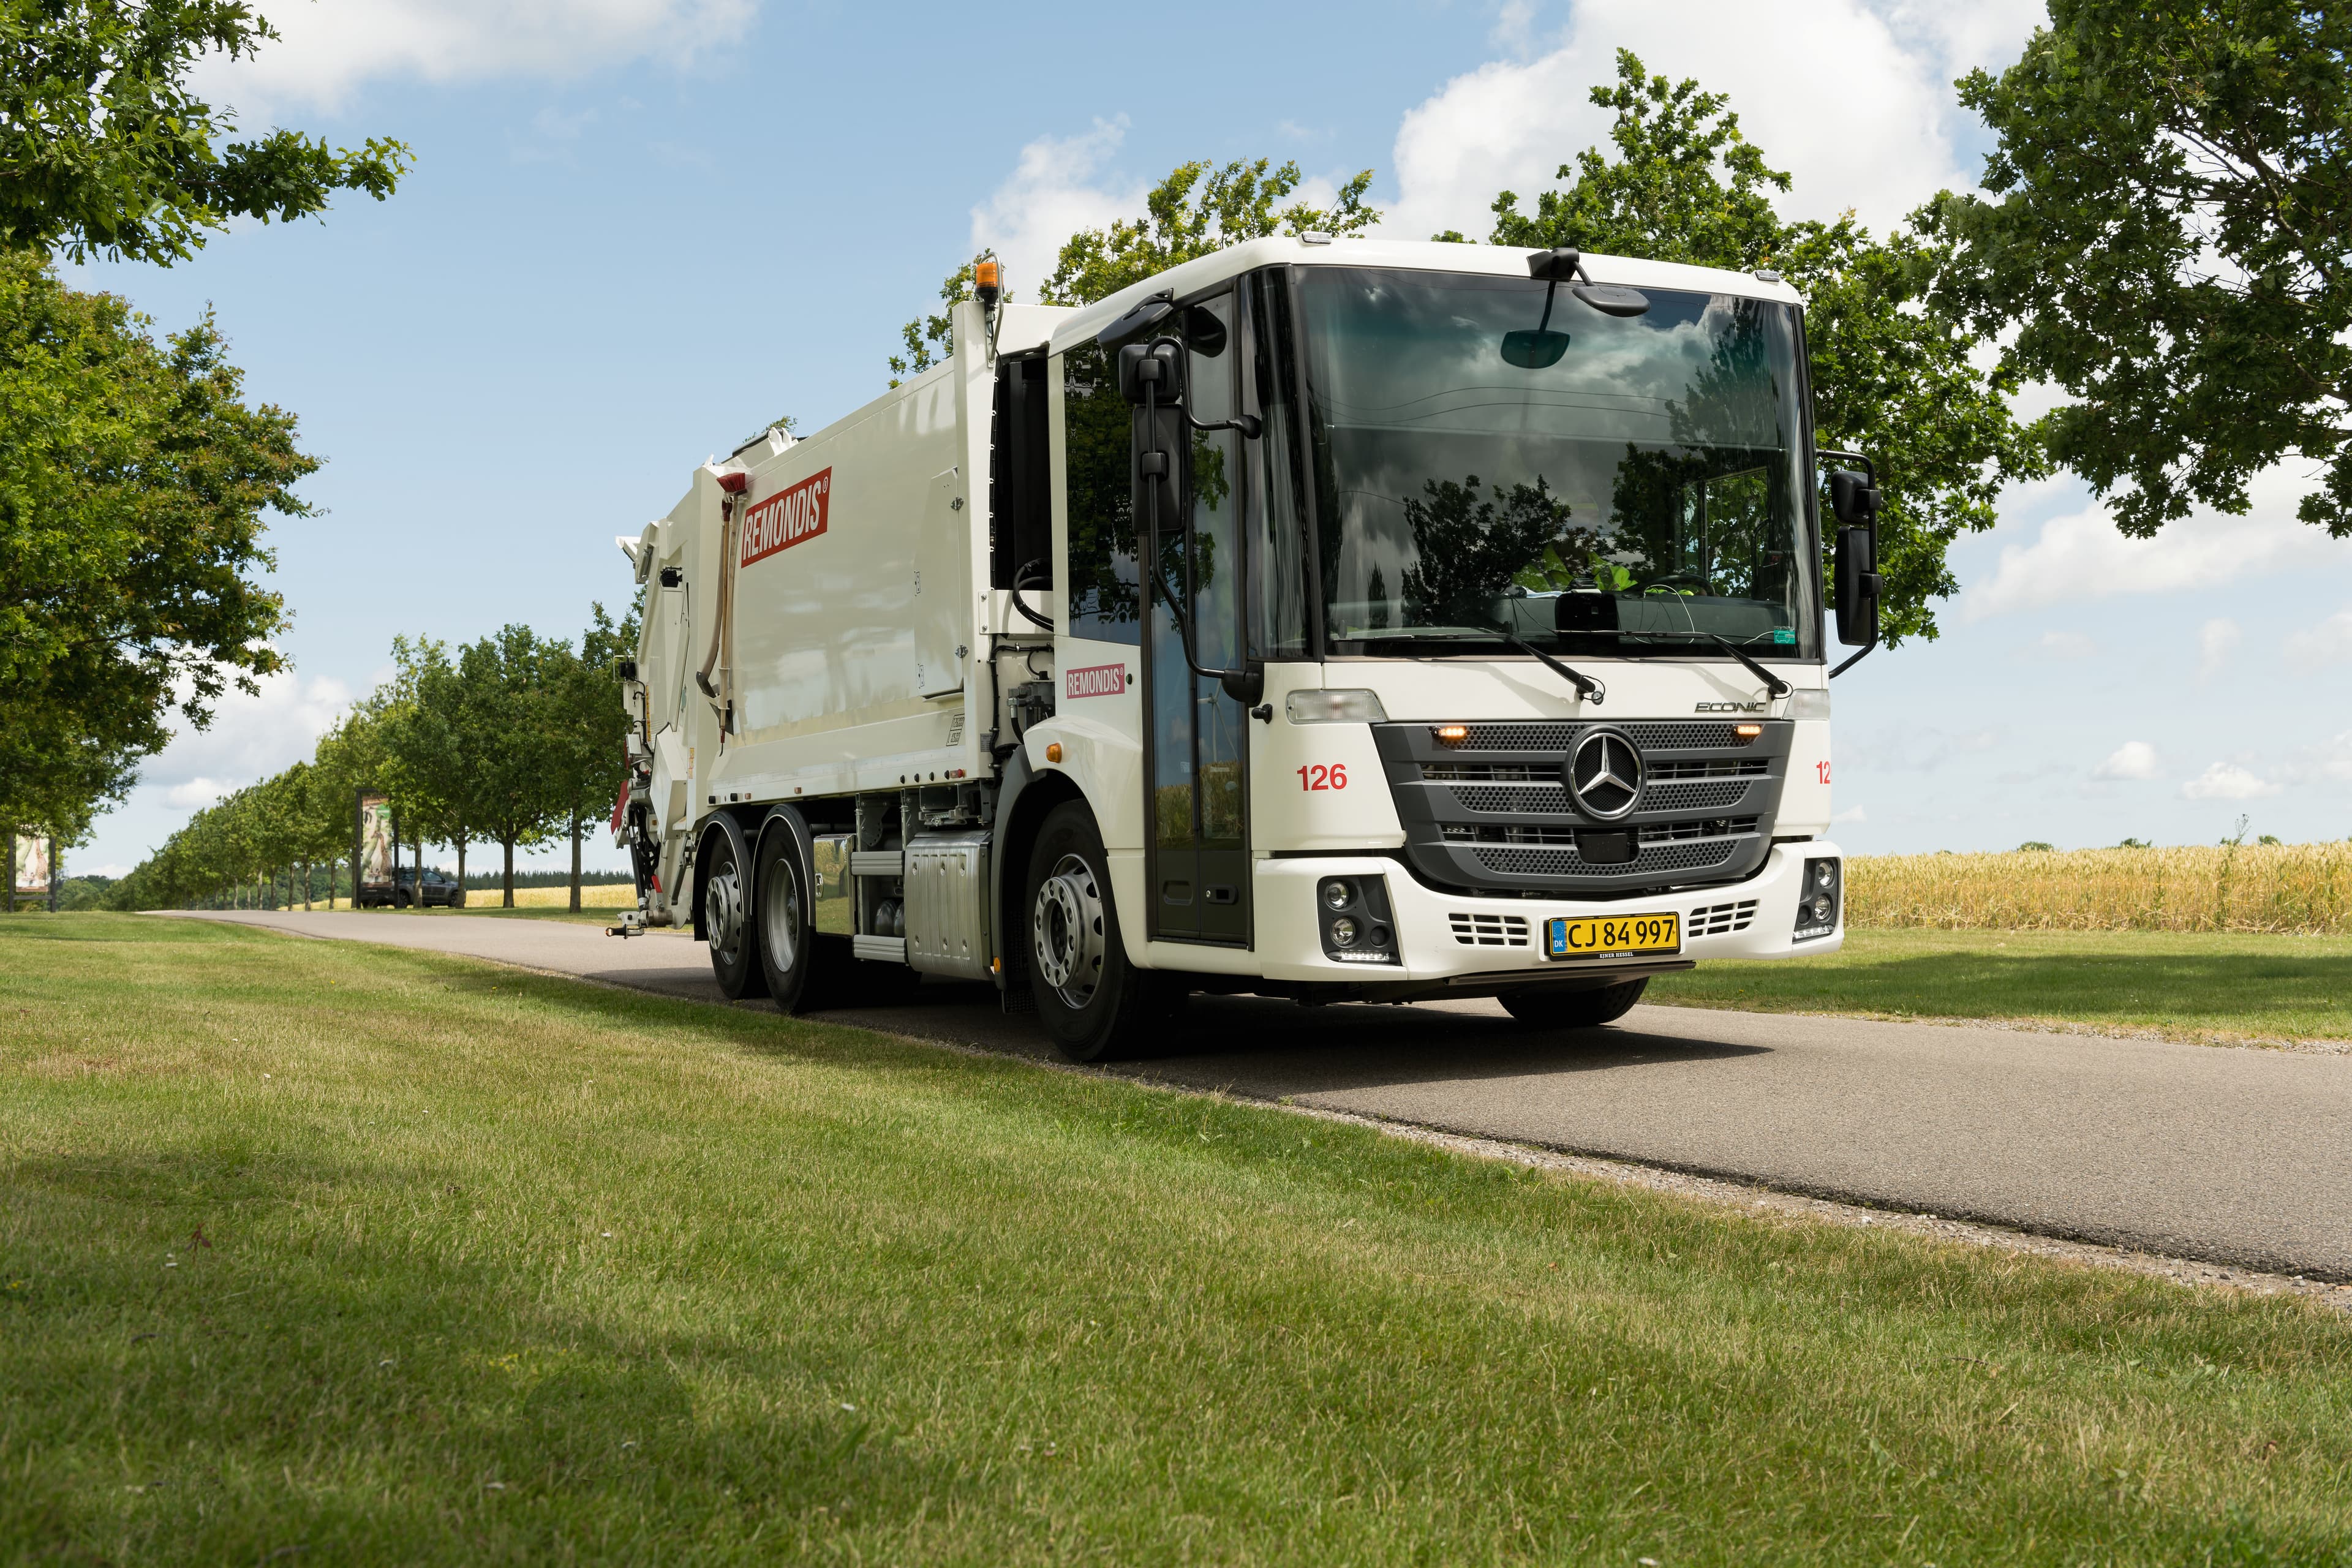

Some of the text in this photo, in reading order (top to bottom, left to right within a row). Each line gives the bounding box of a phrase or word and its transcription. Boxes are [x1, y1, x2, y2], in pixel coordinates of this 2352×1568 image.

[1694, 702, 1766, 713] ECONIC
[1297, 763, 1348, 791] 126
[1635, 919, 1674, 945] 997
